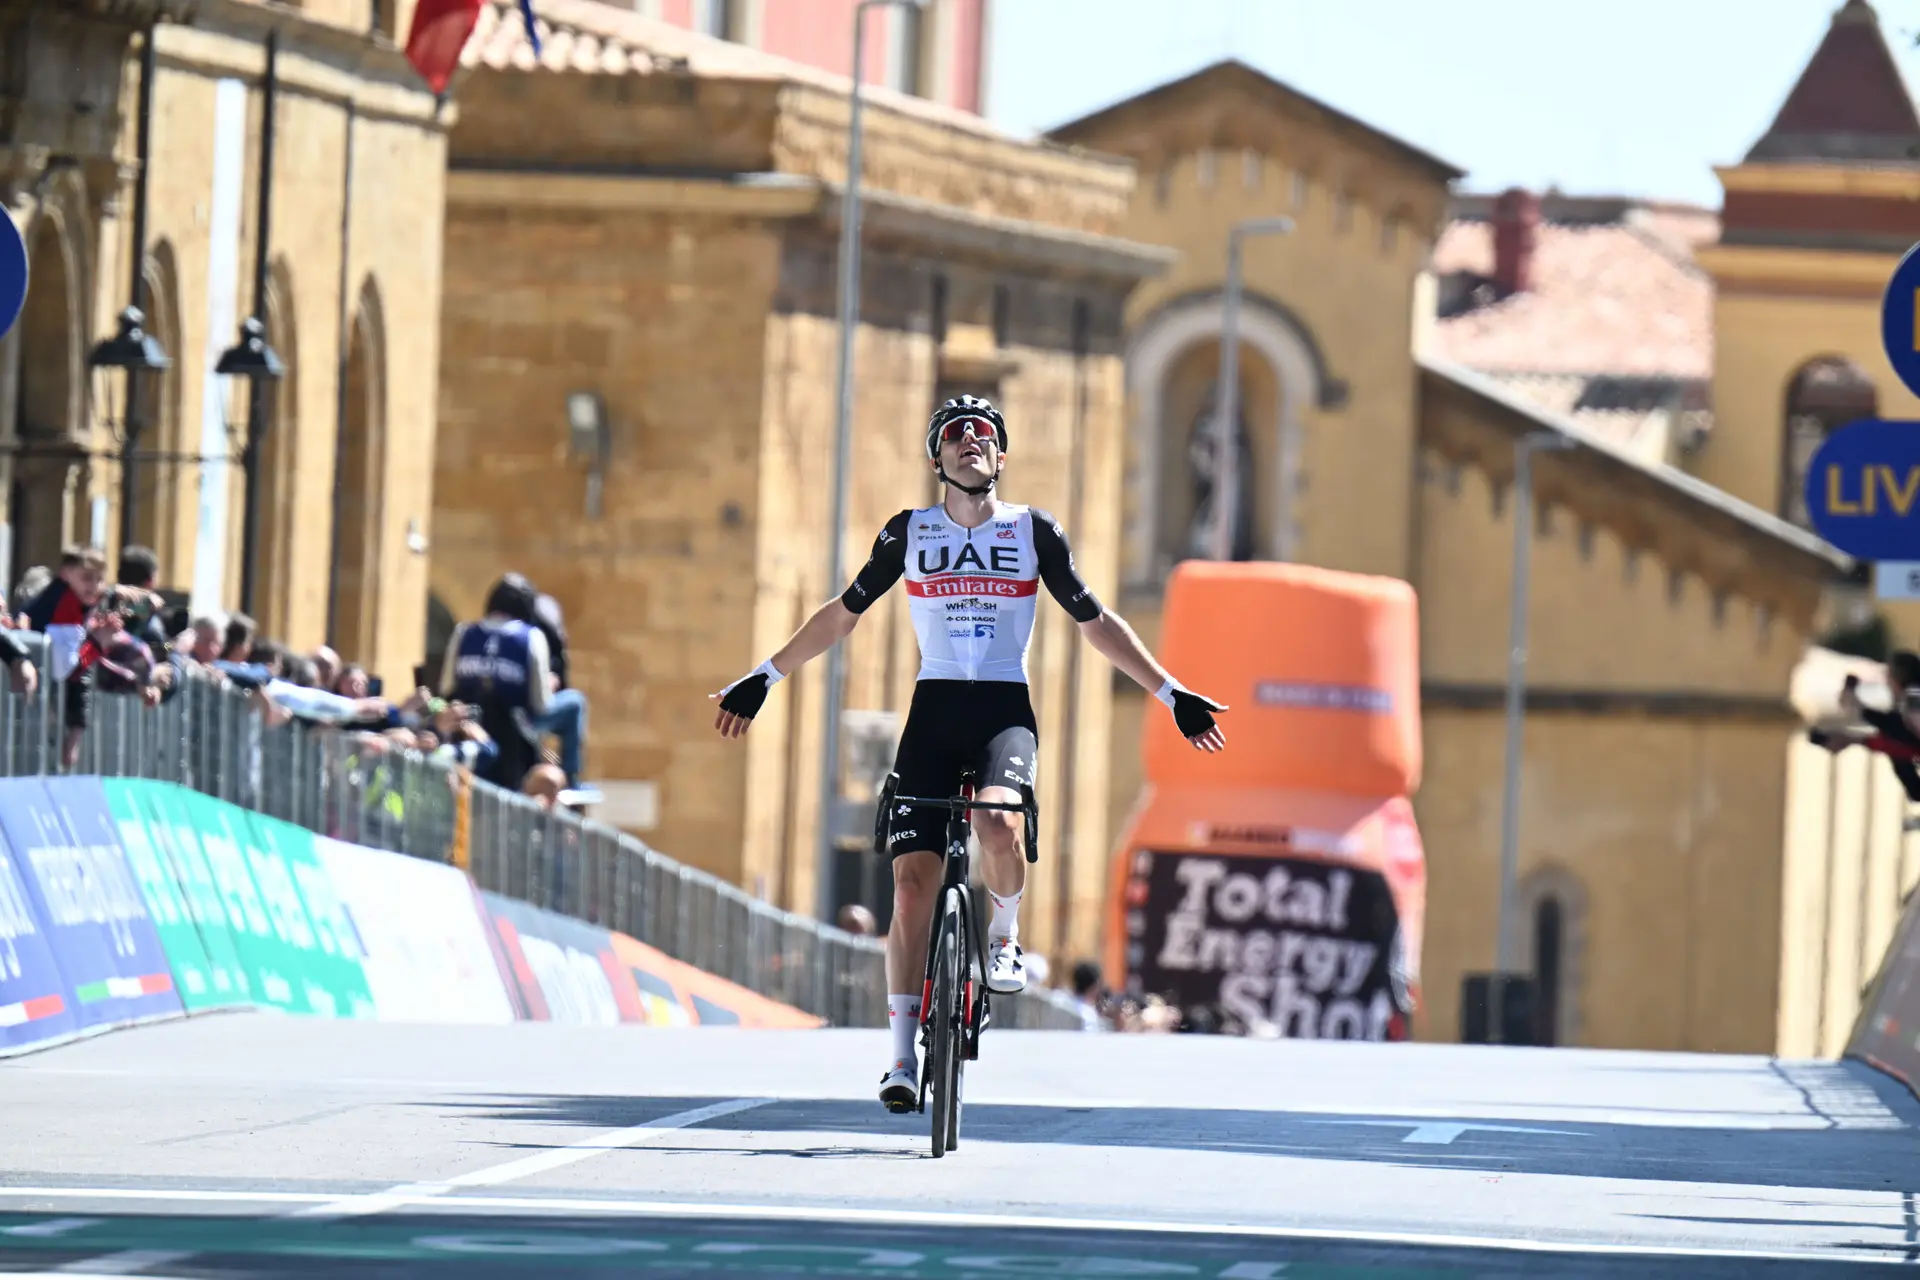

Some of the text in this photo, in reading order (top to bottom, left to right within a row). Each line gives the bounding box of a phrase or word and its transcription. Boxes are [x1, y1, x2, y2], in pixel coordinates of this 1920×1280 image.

[918, 542, 1020, 575] UAE
[921, 579, 1018, 597] Emirates
[1175, 857, 1353, 931] Total
[1157, 911, 1378, 994] Energy
[1219, 970, 1392, 1041] Shot
